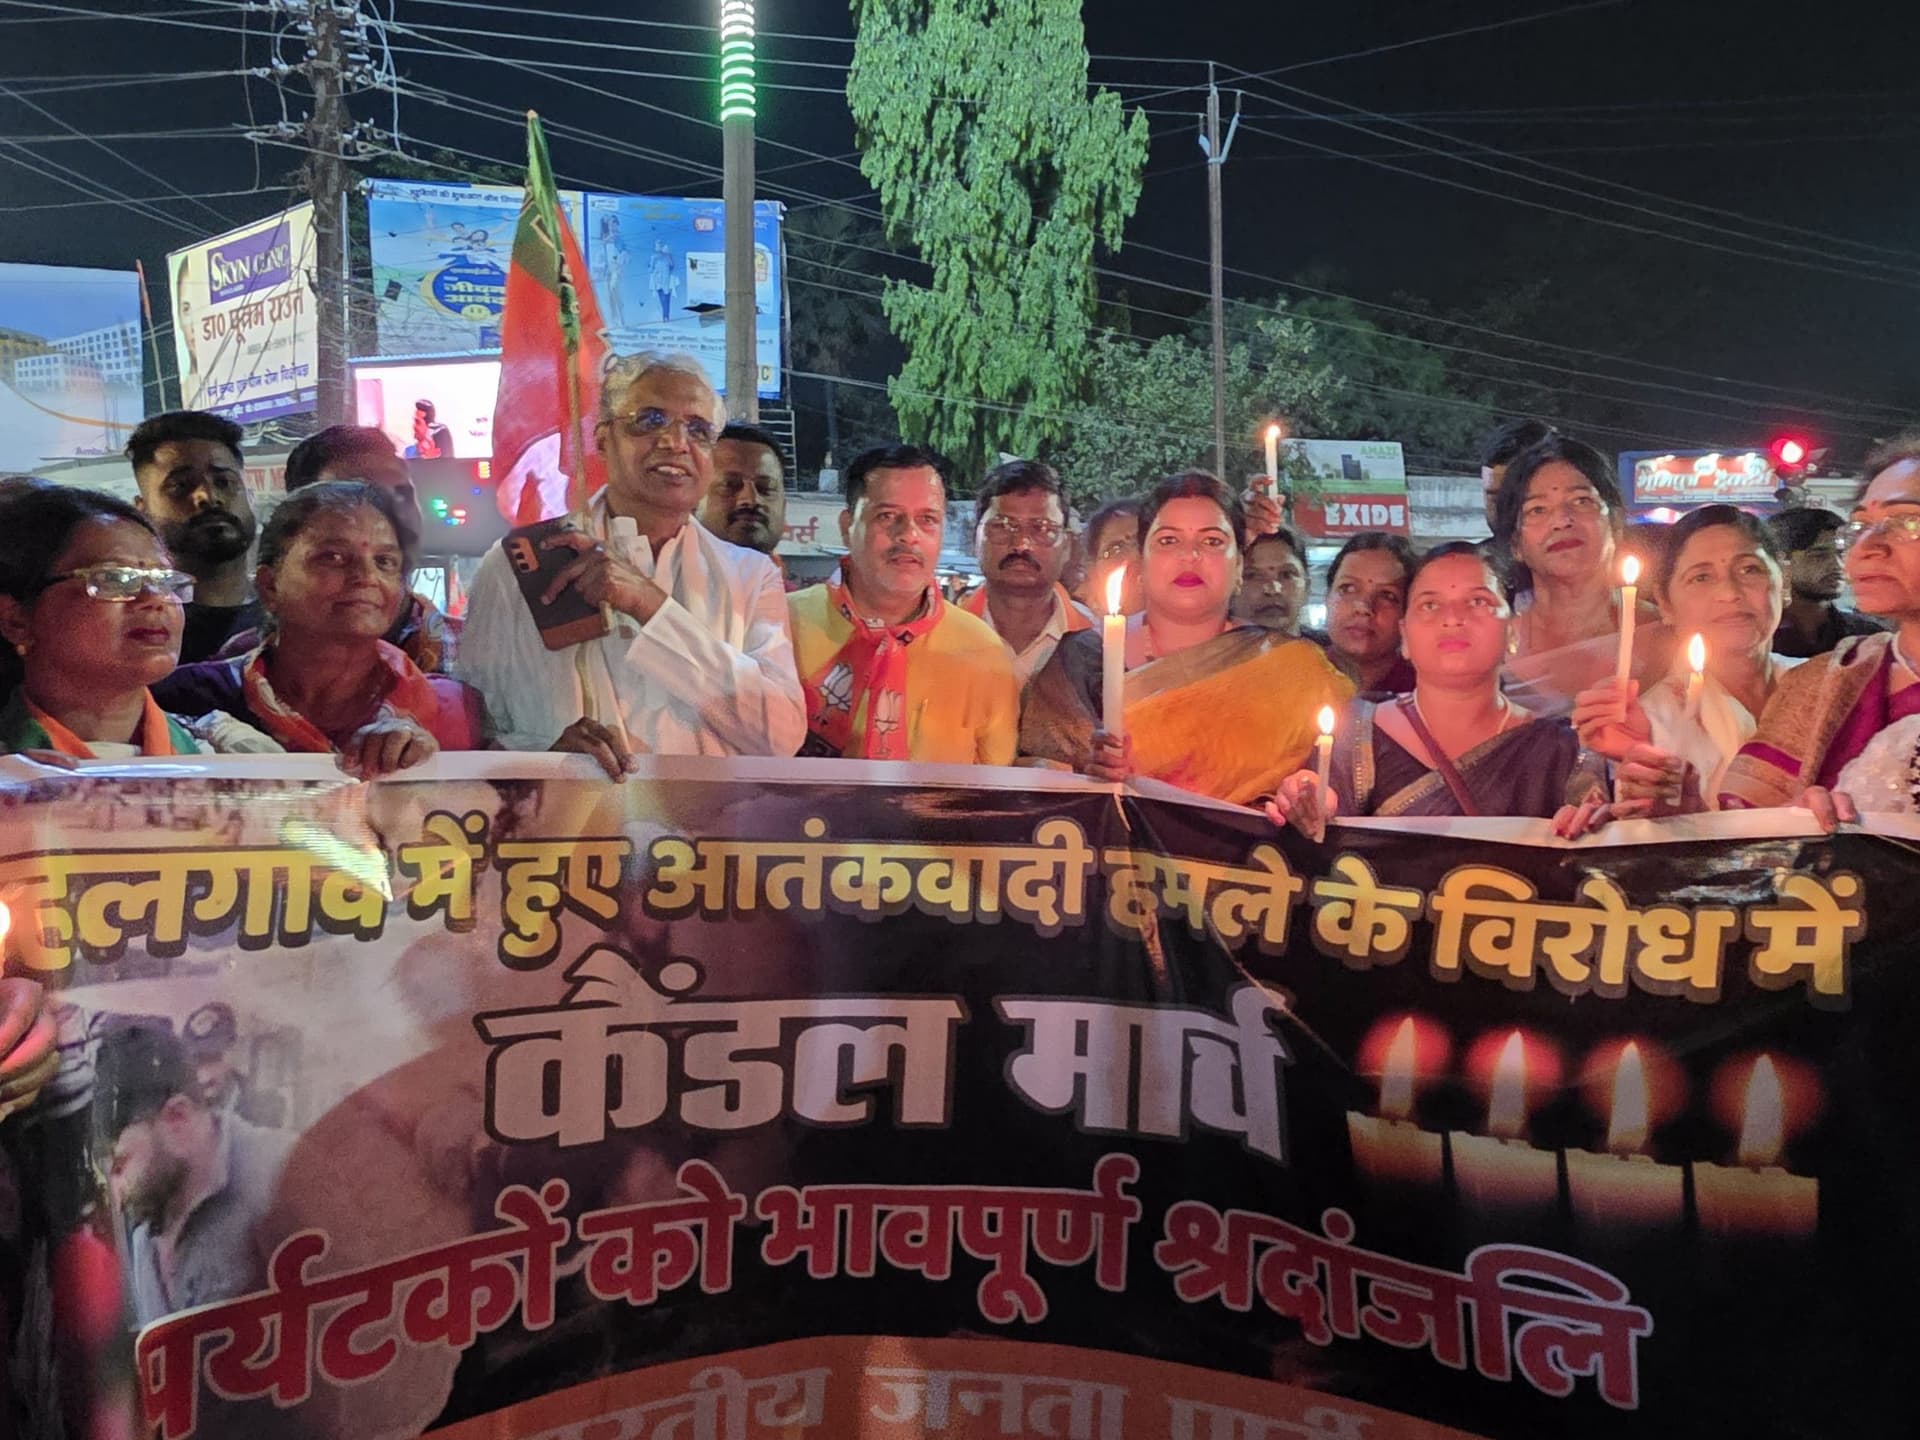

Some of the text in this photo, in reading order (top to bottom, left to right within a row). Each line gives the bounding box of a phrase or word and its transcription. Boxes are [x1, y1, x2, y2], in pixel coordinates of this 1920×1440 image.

[1324, 503, 1405, 527] EXIDE
[401, 812, 486, 921] में
[499, 840, 631, 958] हुए
[646, 817, 1093, 928] आतंकवादी
[1103, 844, 1302, 944] हमले
[1312, 855, 1421, 956] के
[1432, 867, 1737, 989] विरोध
[1749, 872, 1861, 996] में
[1002, 984, 1288, 1162] मार्च
[136, 1178, 568, 1440] पर्यटकों
[577, 1158, 747, 1305] को
[756, 1153, 1141, 1323] भावपूर्ण
[865, 1366, 1128, 1440] जनता
